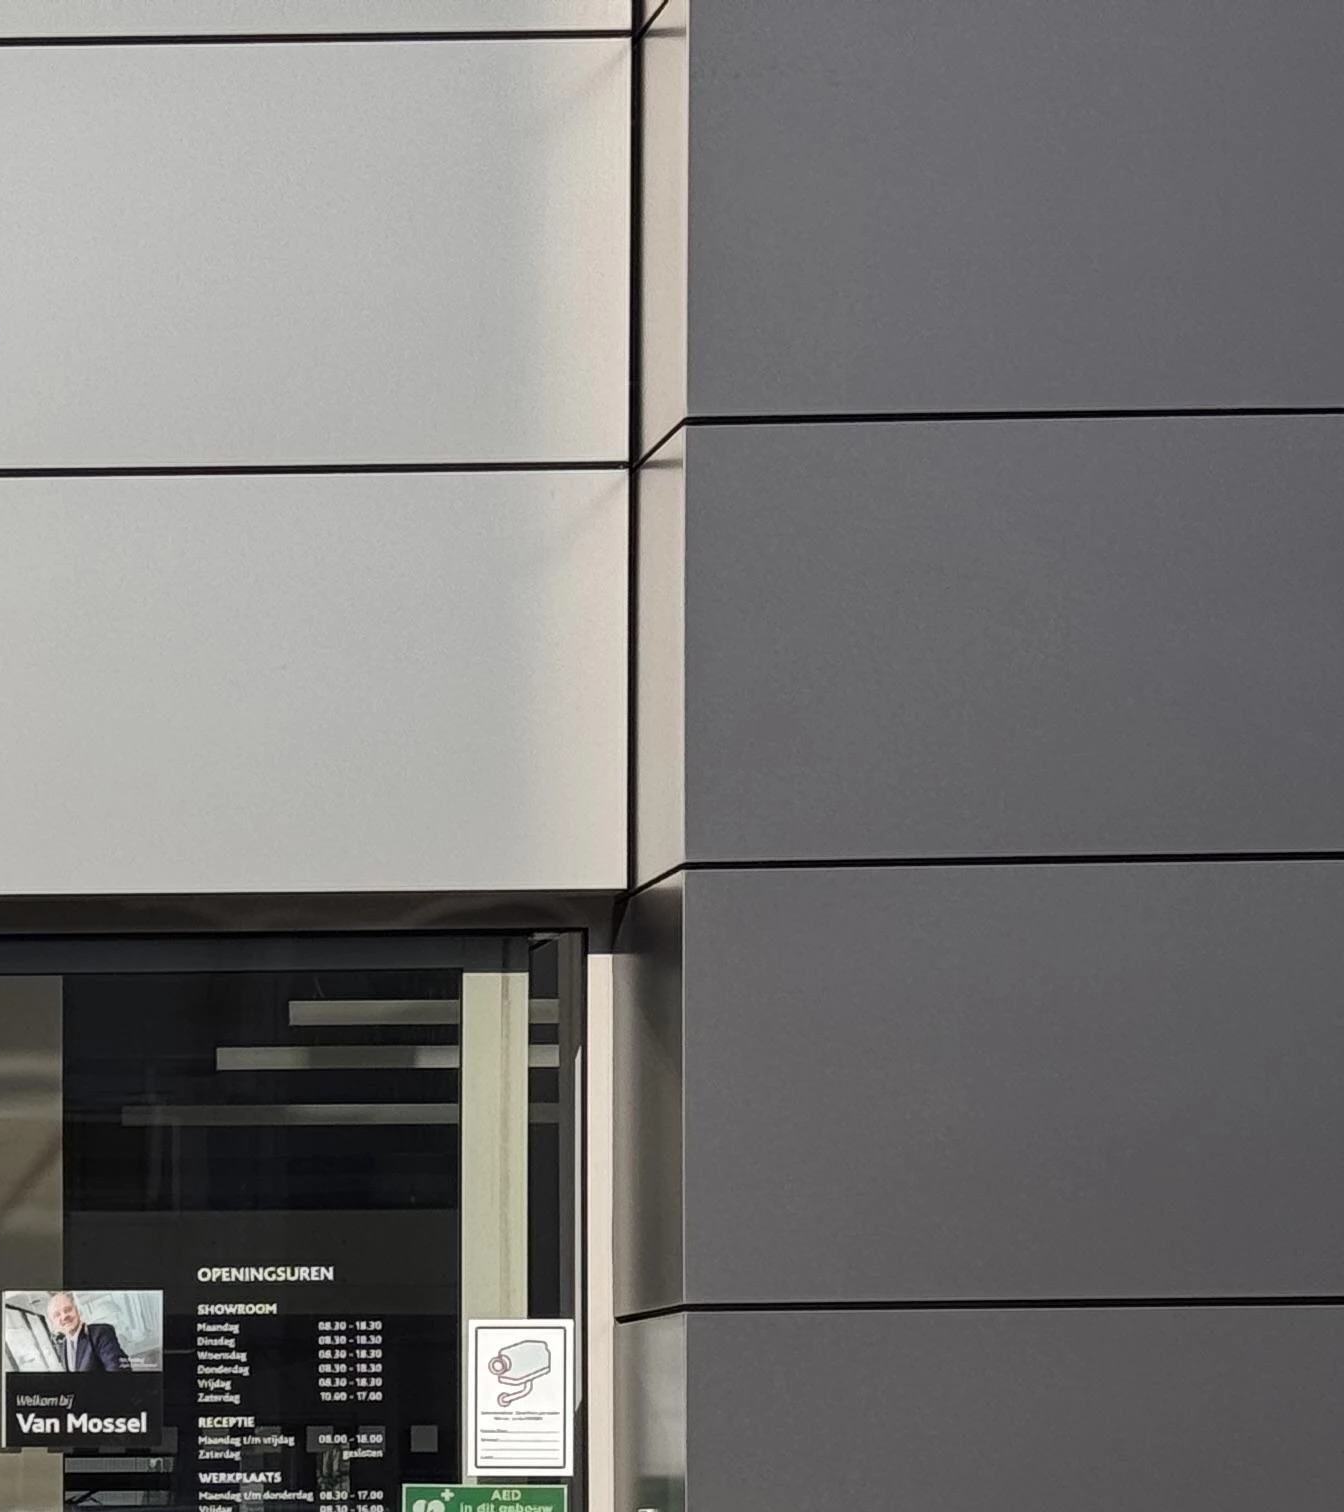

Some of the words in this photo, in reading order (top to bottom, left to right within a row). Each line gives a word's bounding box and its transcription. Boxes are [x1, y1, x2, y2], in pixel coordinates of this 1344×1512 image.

[197, 1266, 334, 1282] OPENINGSUREN
[197, 1303, 278, 1315] SHOWROOM
[197, 1323, 240, 1334] Maandag
[197, 1337, 236, 1348] Dinsdag
[197, 1351, 247, 1362] Woensdag
[197, 1365, 250, 1376] Donderdag
[197, 1379, 232, 1390] Vrijdag
[16, 1395, 58, 1407] Welkom
[59, 1395, 74, 1409] bij
[197, 1393, 241, 1405] Zaterdag
[16, 1413, 60, 1433] Van
[67, 1411, 147, 1433] Mossel
[198, 1416, 255, 1428] RECEPTIE
[199, 1472, 282, 1484] WERKPLAATS
[490, 1490, 522, 1501] AED
